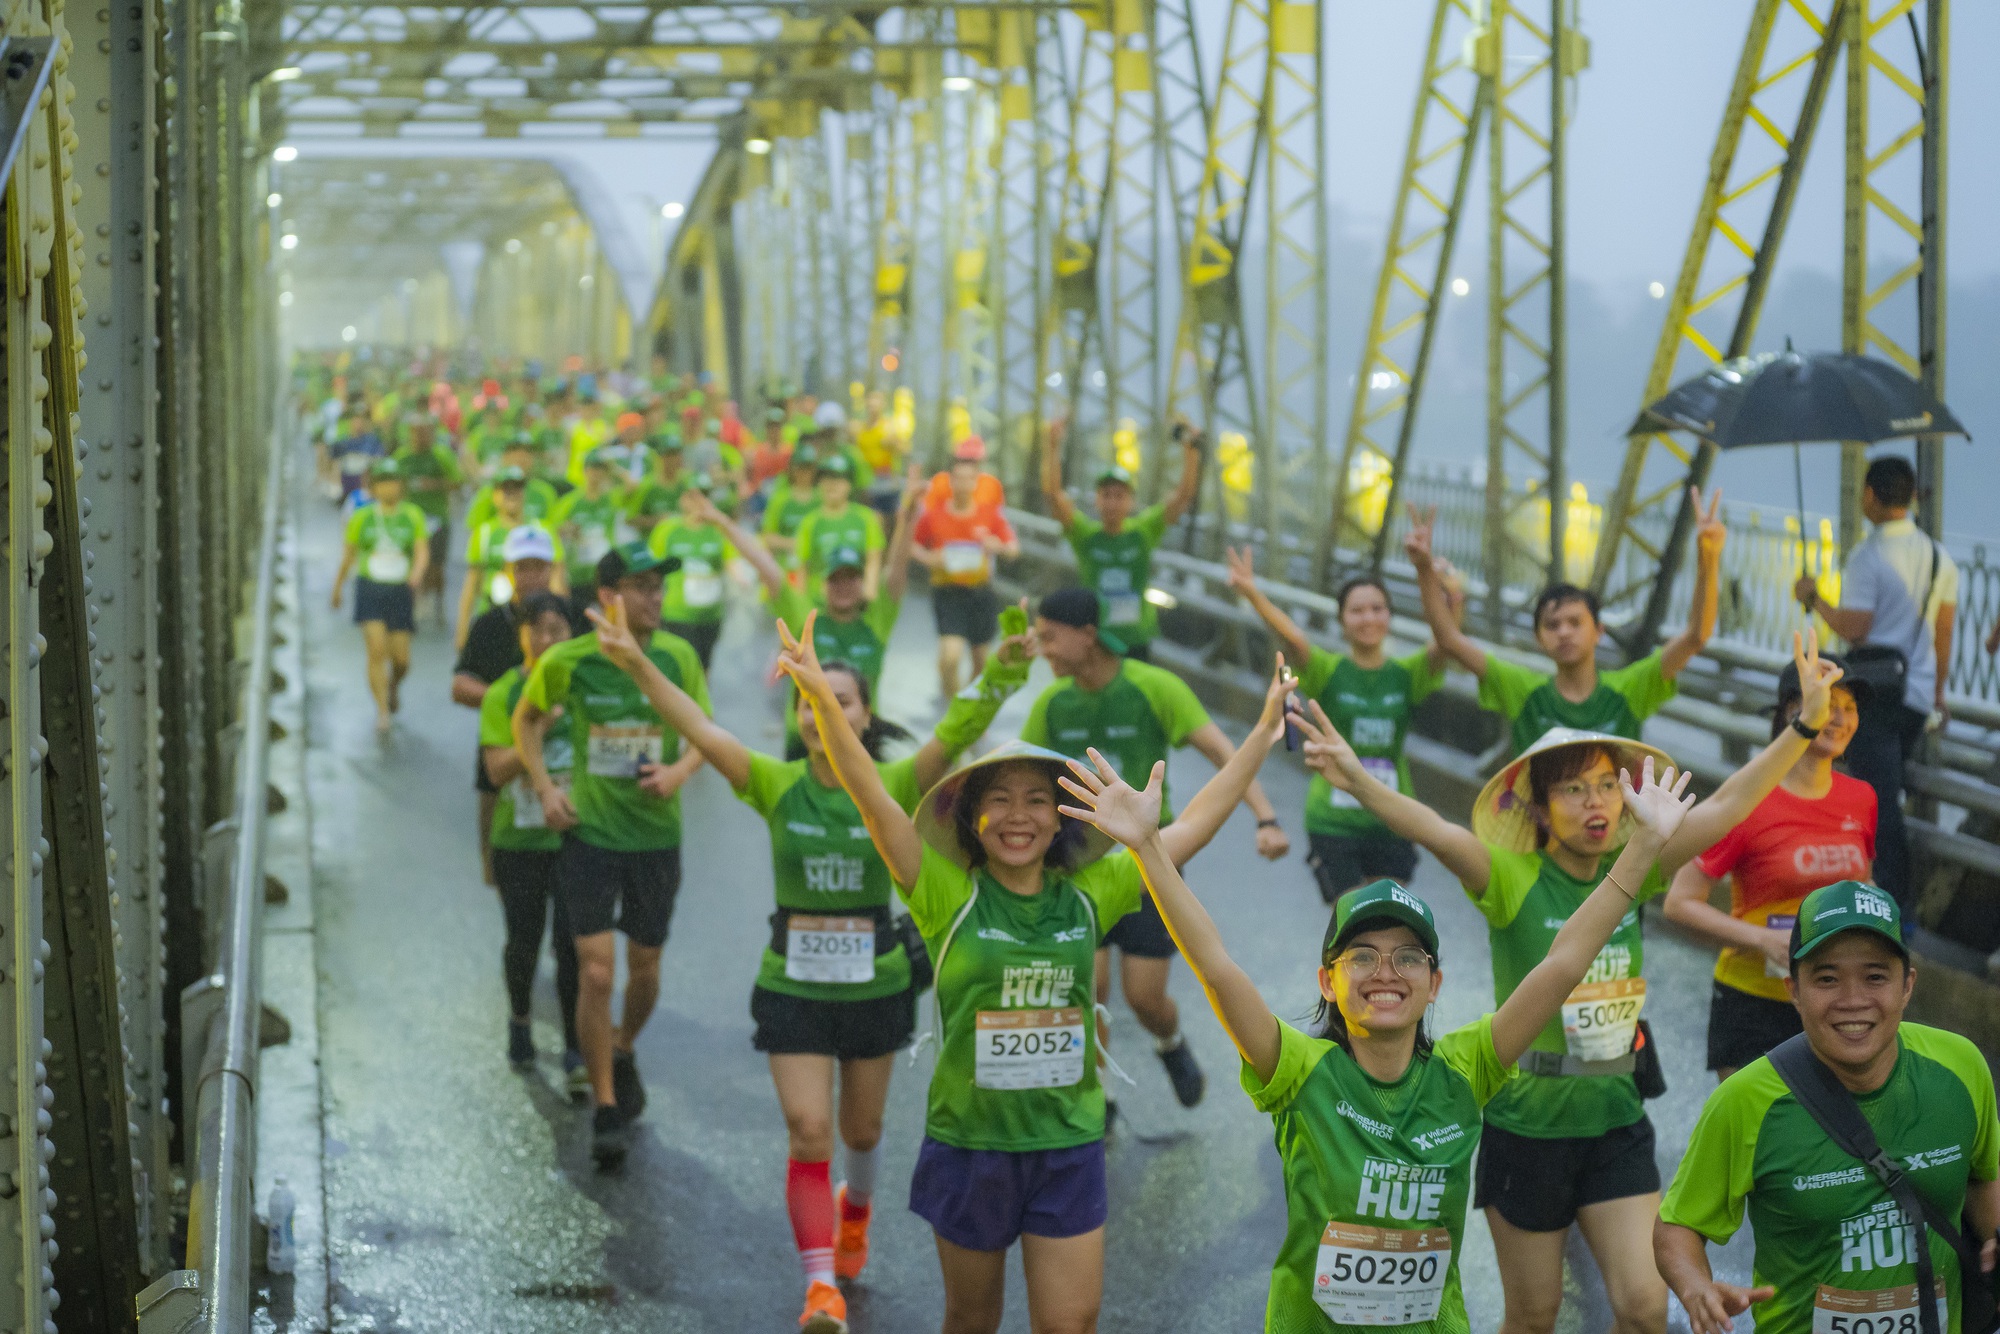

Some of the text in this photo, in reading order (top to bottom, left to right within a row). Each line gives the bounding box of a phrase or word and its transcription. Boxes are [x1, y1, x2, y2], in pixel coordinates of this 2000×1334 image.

[806, 865, 863, 891] HUE
[1856, 899, 1893, 923] HUE
[800, 934, 862, 954] 52051
[1003, 968, 1075, 981] IMPERIAL
[1581, 957, 1631, 984] HUE
[1001, 980, 1074, 1008] HUE
[1578, 1001, 1636, 1029] 50072
[991, 1031, 1072, 1056] 52052
[1427, 1123, 1460, 1139] VnExpress
[1433, 1130, 1464, 1146] Marathon
[1925, 1144, 1961, 1159] VnExpress
[1930, 1153, 1963, 1167] Marathon
[1362, 1159, 1447, 1183] IMPERIAL
[1808, 1166, 1865, 1182] HERBALIFE
[1807, 1174, 1866, 1190] NUTRITION
[1356, 1176, 1446, 1220] HUE
[1871, 1200, 1896, 1213] 2023
[1331, 1252, 1438, 1286] 50290
[1831, 1313, 1918, 1334] 5028
